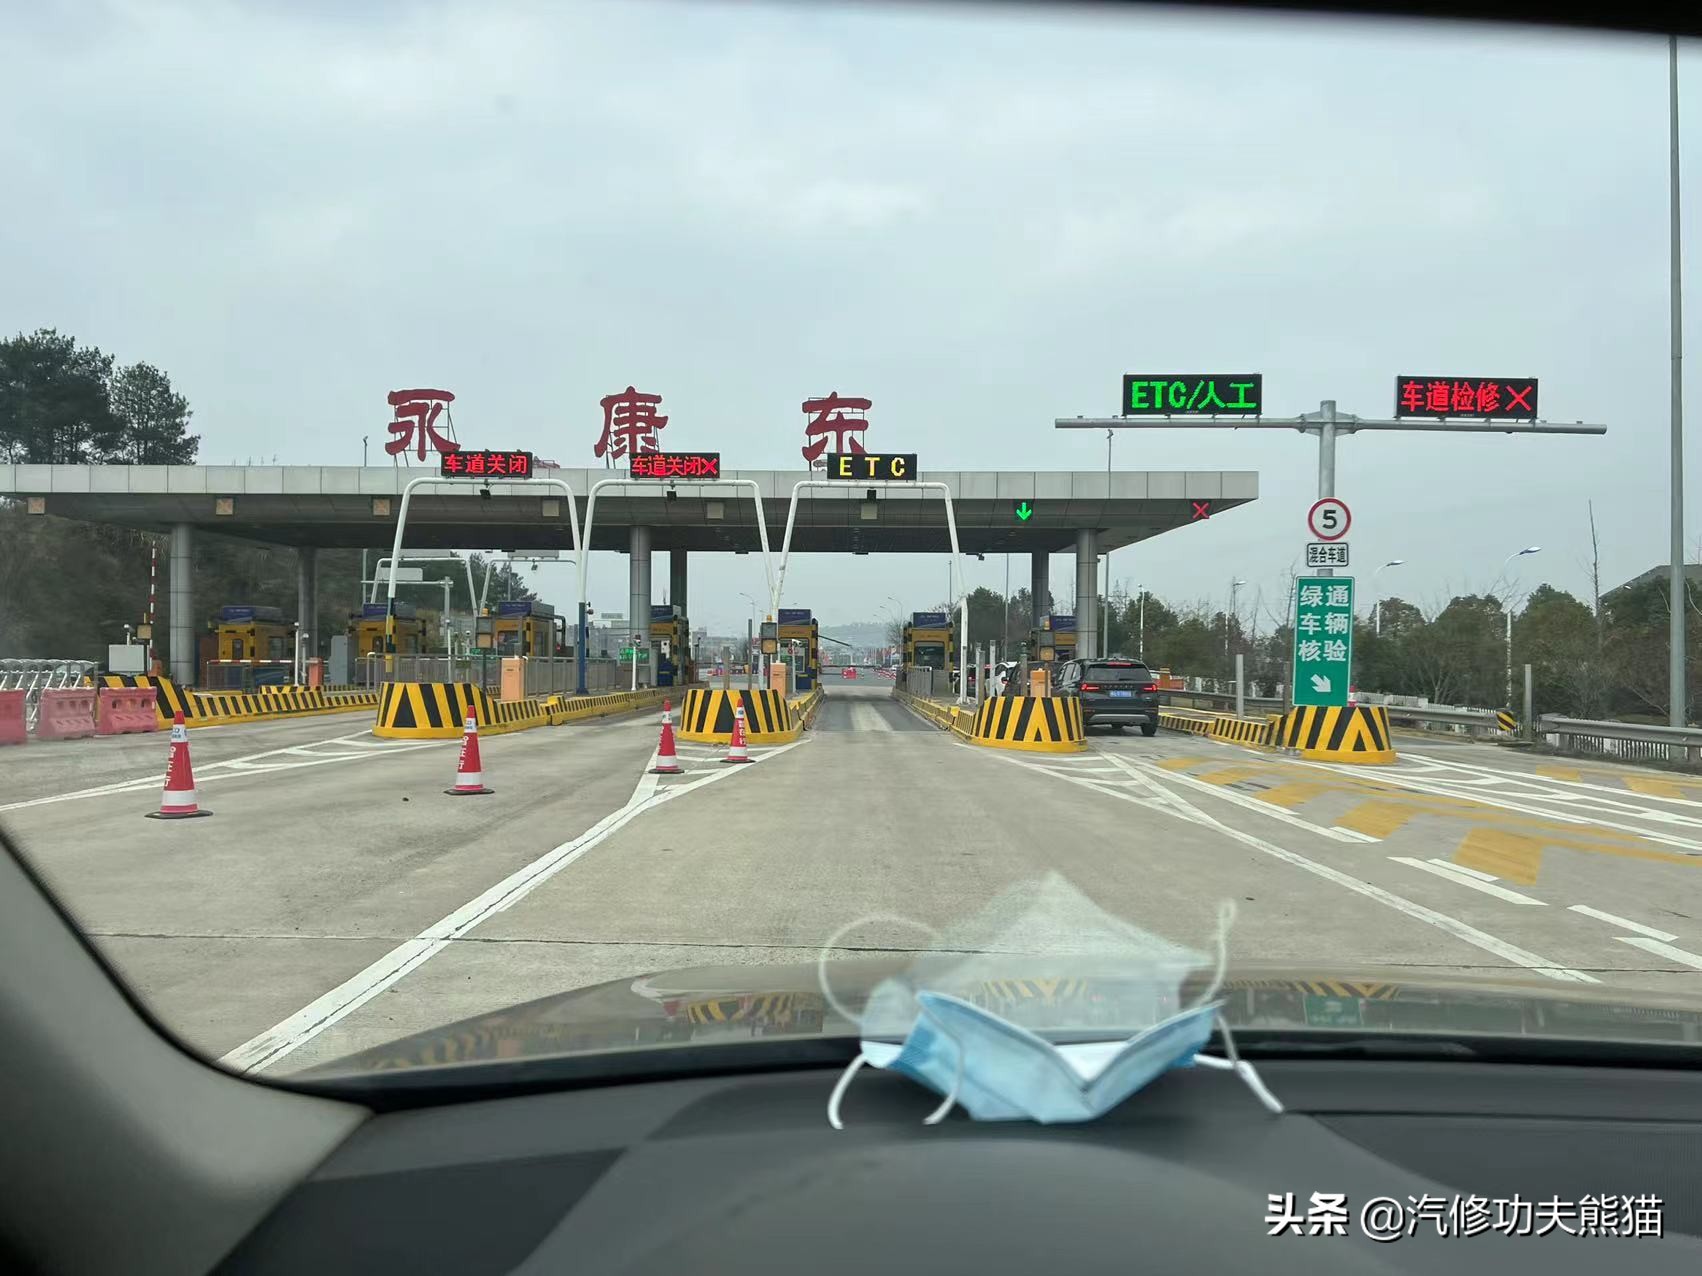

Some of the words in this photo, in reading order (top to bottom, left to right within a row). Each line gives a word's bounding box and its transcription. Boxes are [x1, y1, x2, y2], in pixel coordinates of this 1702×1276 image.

[1131, 380, 1257, 409] ETC/人工
[1401, 380, 1500, 412] 车道检修
[444, 453, 528, 474] 车道关闭
[1322, 509, 1337, 530] 5
[1309, 546, 1346, 564] 混合车道
[1300, 585, 1350, 607] 绿通
[1299, 612, 1349, 635] 车辆
[1298, 639, 1348, 663] 核验
